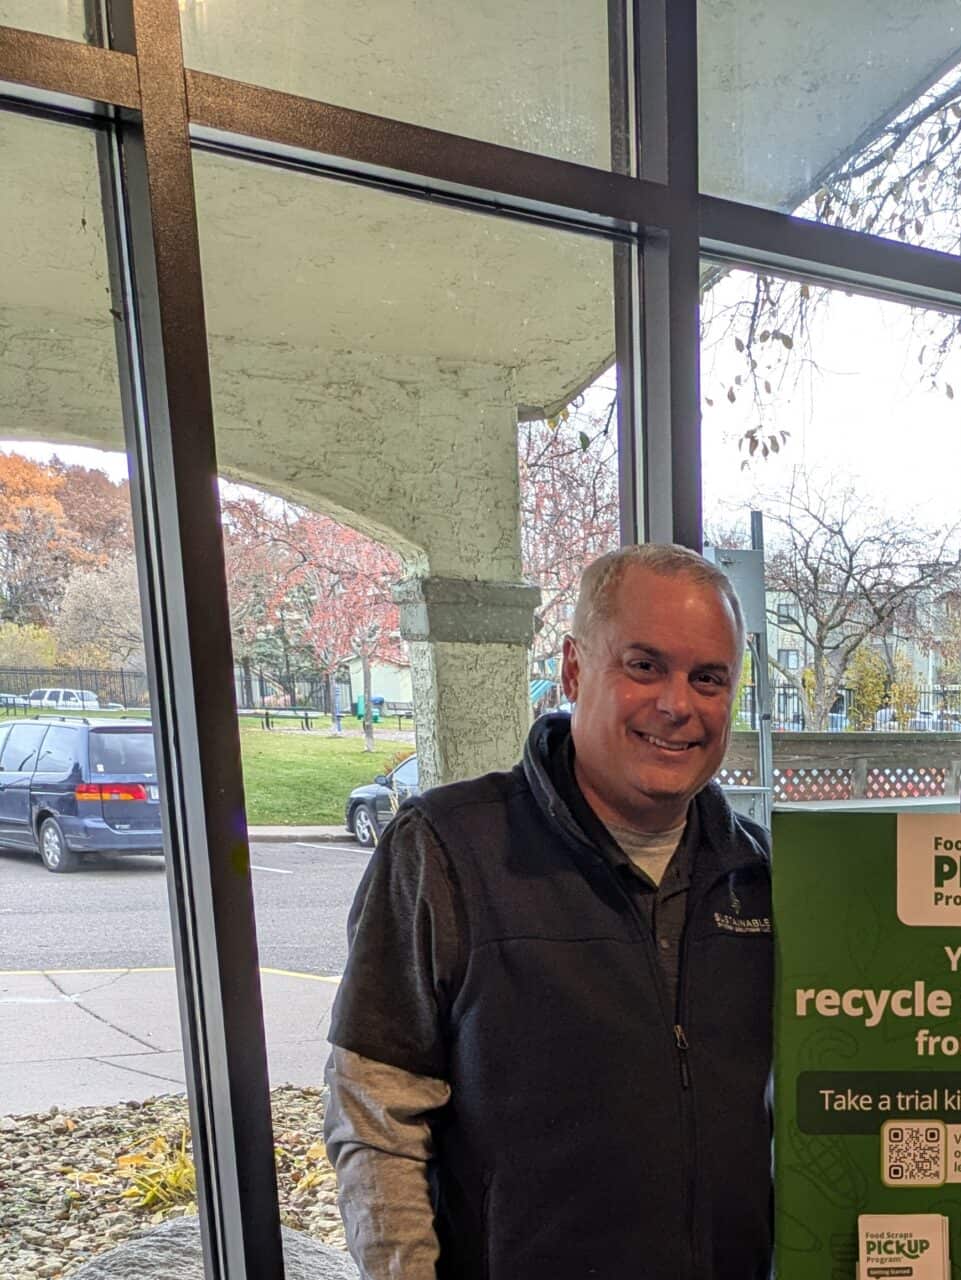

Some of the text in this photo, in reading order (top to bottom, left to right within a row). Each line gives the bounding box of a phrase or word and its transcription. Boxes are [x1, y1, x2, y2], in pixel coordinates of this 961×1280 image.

[796, 981, 952, 1027] recycle
[819, 1089, 872, 1111] Take
[878, 1094, 891, 1111] a
[896, 1089, 937, 1111] trial
